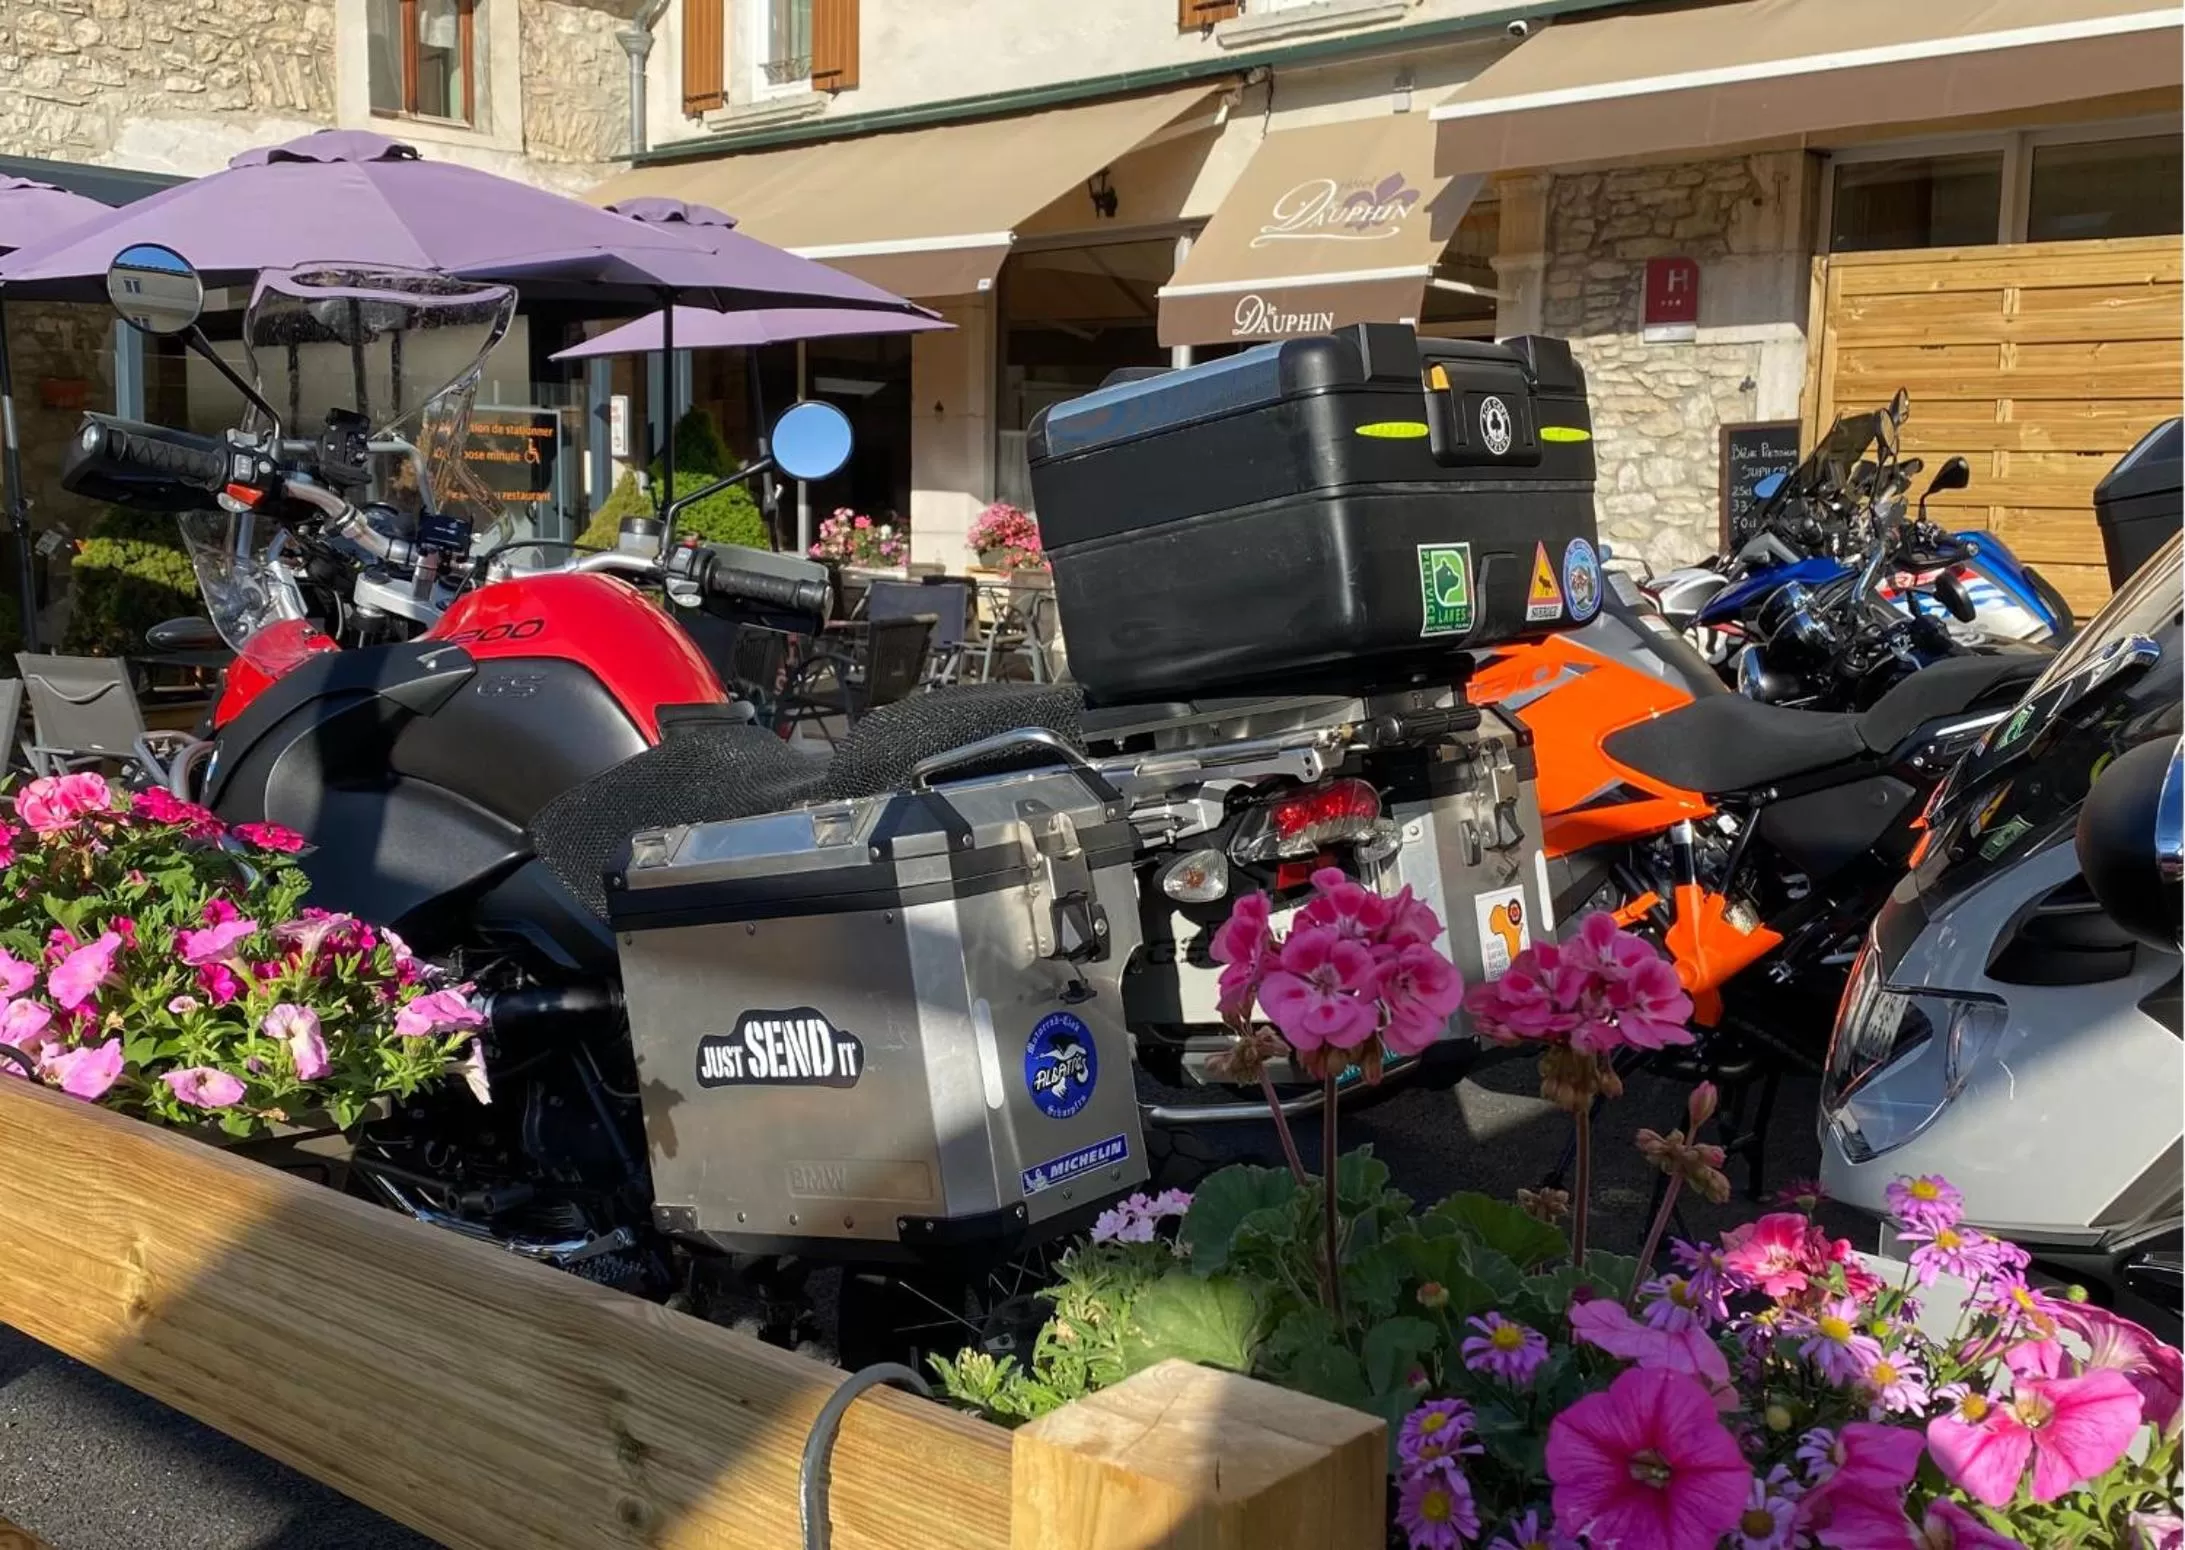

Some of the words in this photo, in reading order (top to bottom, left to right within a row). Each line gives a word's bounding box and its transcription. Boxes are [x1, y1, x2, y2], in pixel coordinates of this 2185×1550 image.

[1668, 268, 1689, 293] H
[506, 425, 553, 437] stationner
[486, 451, 521, 462] minute
[503, 491, 551, 501] restaurant
[1421, 550, 1436, 625] PLITVICE
[701, 1046, 744, 1079] JUST
[743, 1018, 835, 1079] SEND
[837, 1042, 858, 1077] IT
[1050, 1141, 1122, 1178] MICHELIN
[791, 1165, 848, 1191] BMW
